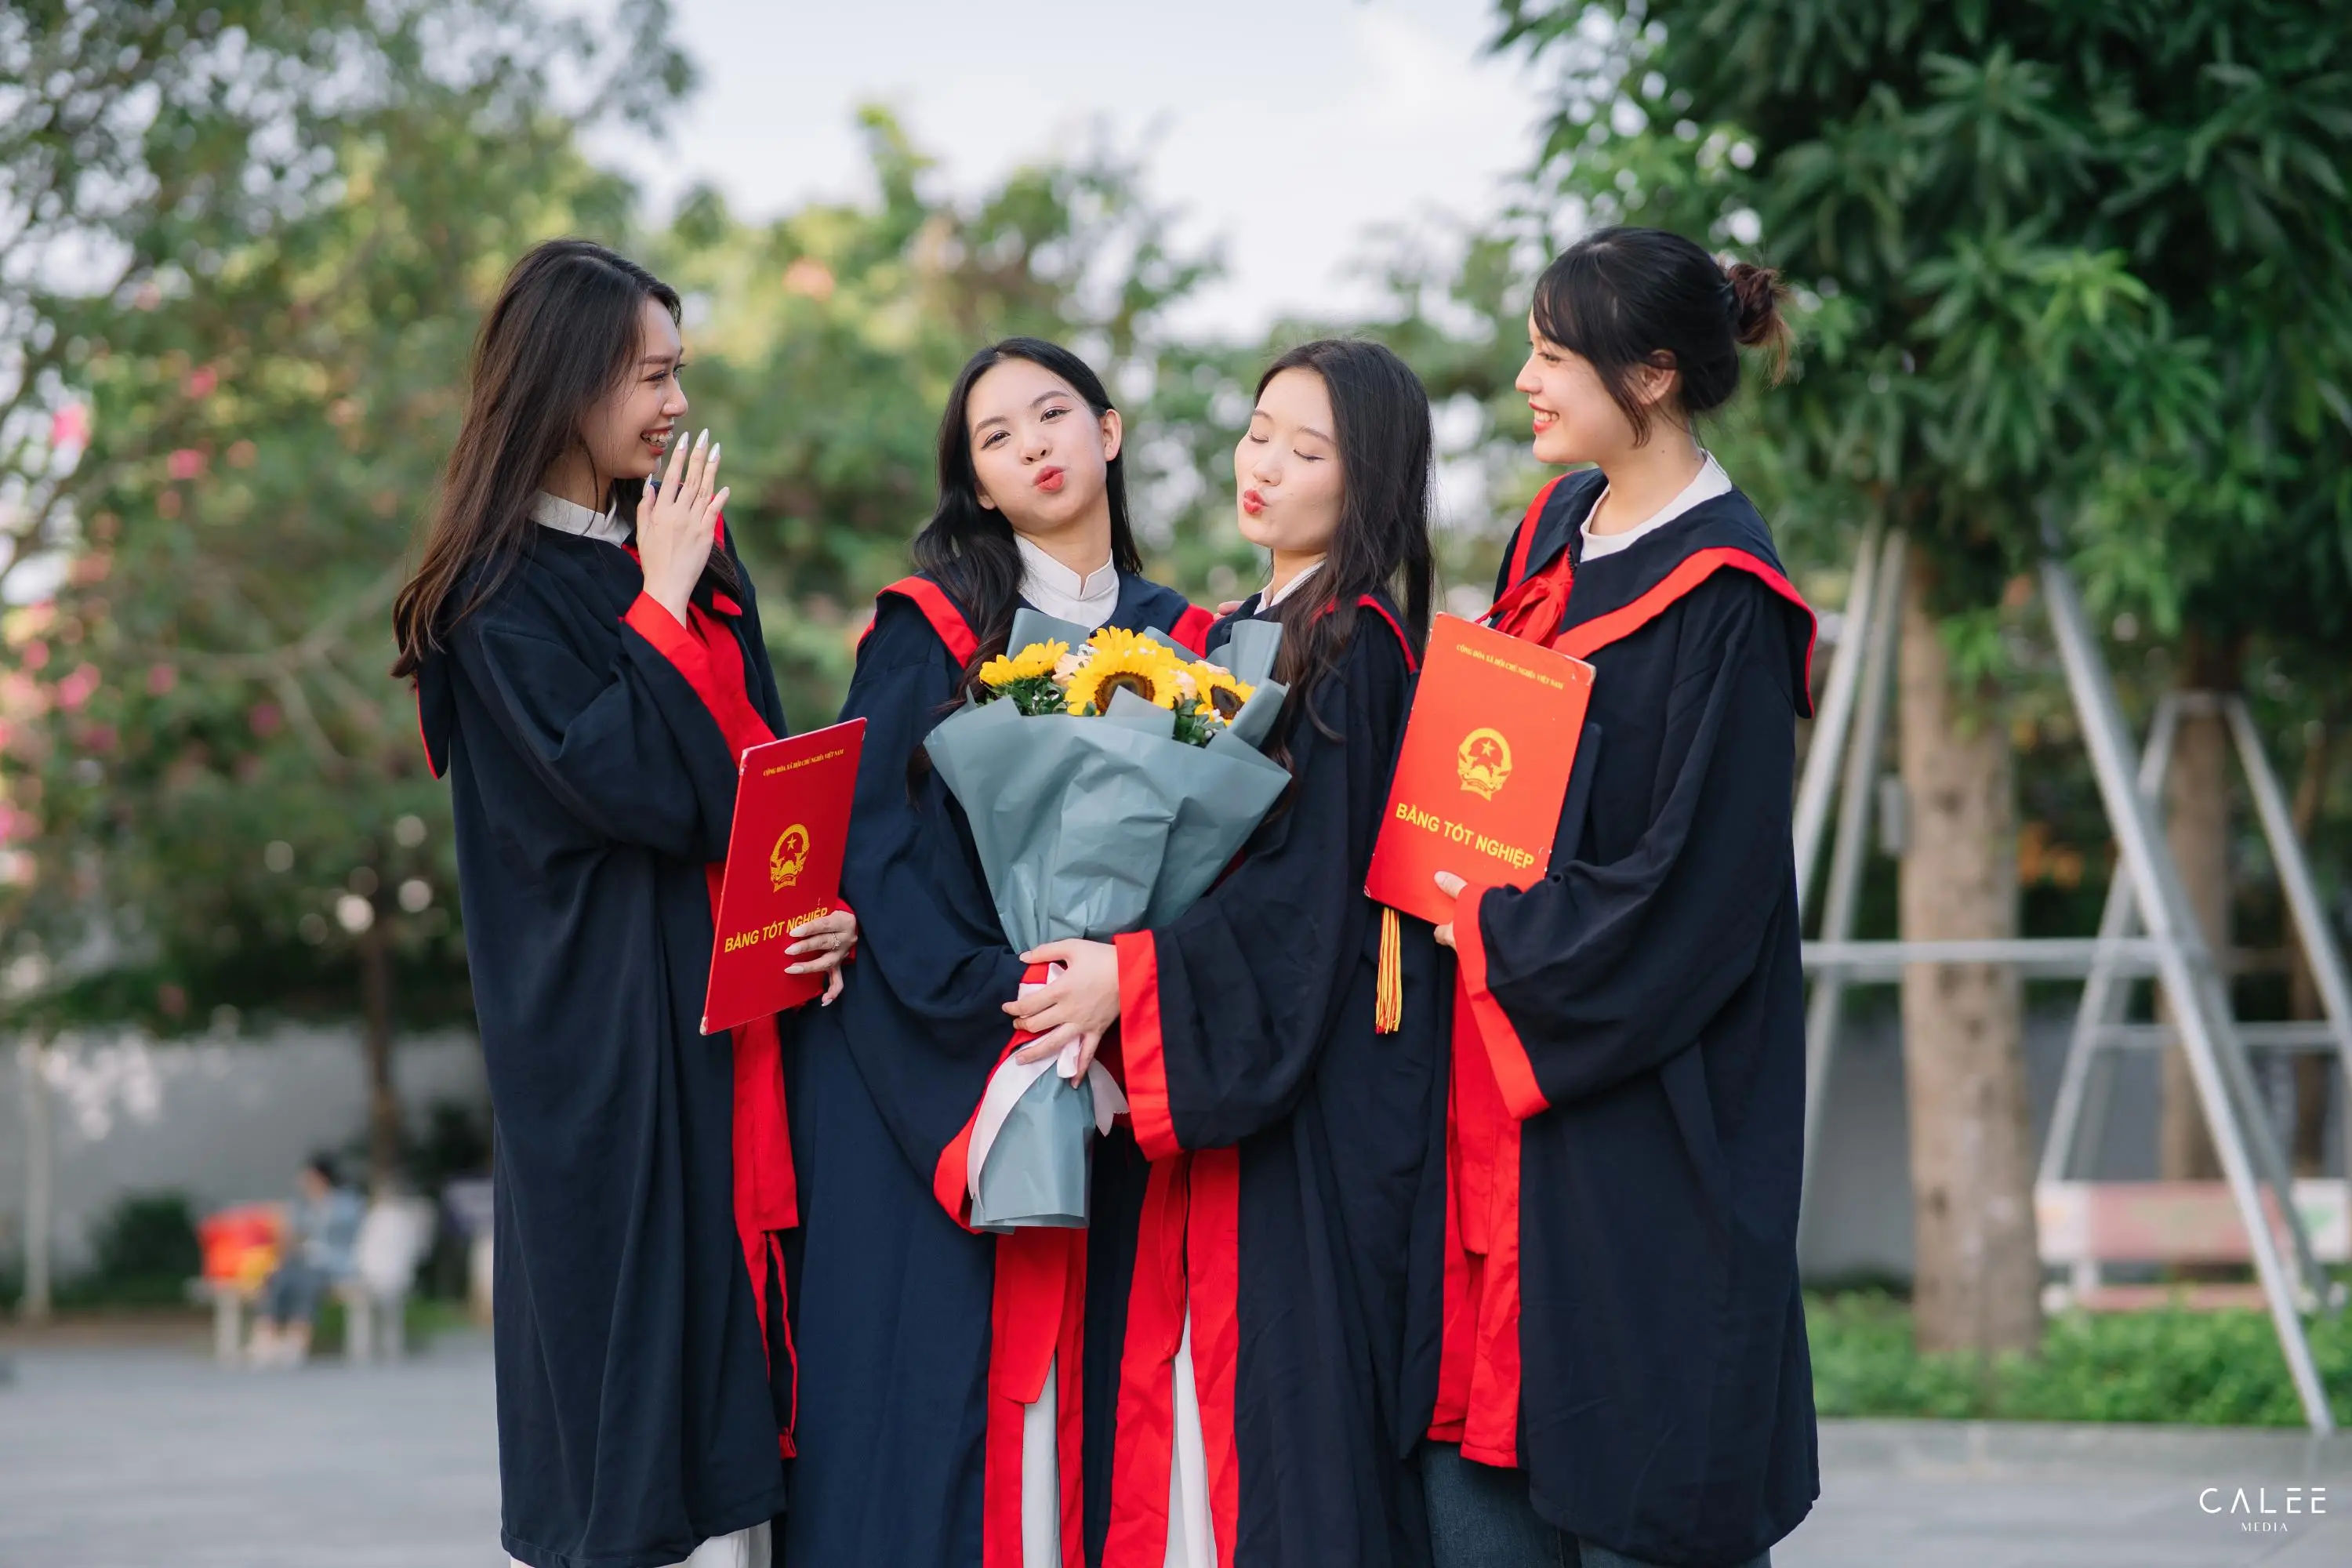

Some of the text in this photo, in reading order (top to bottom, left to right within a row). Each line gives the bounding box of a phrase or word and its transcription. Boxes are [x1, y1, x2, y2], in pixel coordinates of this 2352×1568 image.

[1443, 820, 1474, 845] TỐT
[1475, 834, 1535, 869] NGHIỆP
[762, 920, 785, 941] TỐT
